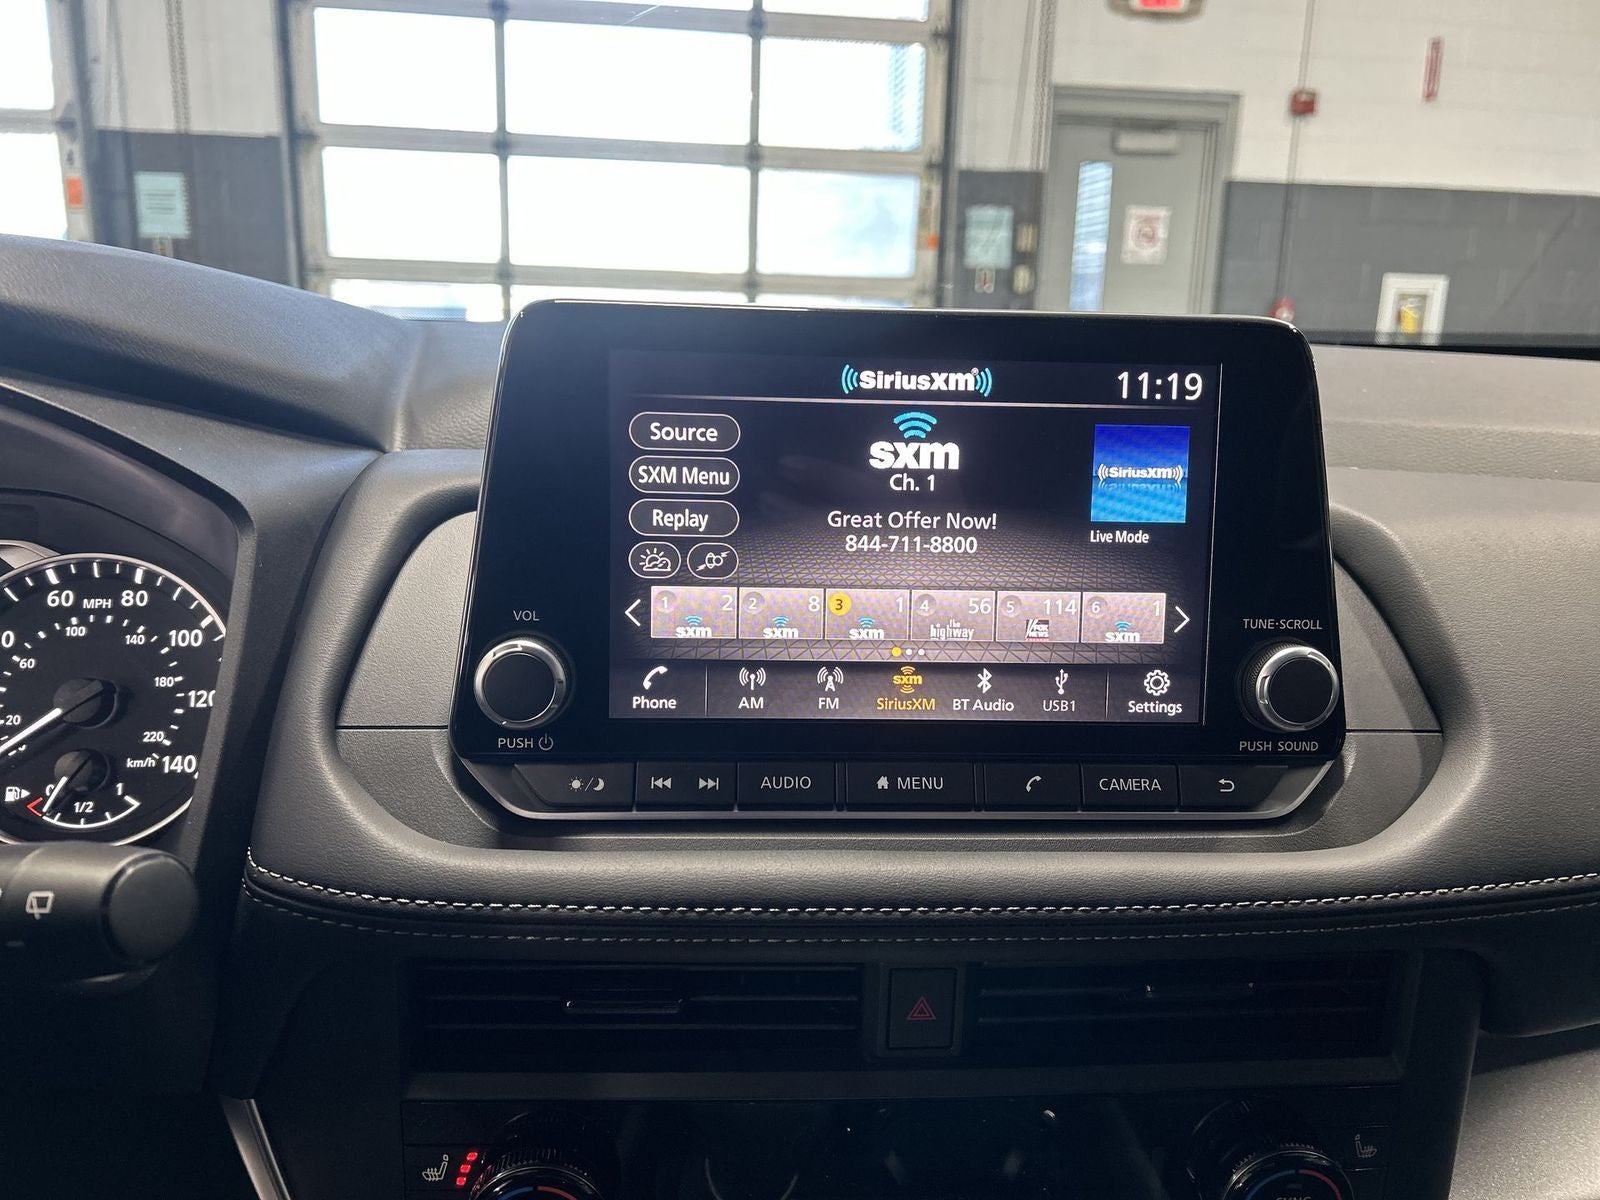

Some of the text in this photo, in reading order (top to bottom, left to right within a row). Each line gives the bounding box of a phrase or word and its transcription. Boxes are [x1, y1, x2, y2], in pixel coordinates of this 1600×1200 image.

[1117, 371, 1204, 401] 11:19
[650, 422, 718, 443] Source
[638, 465, 730, 487] SXM Menu
[889, 473, 936, 492] Ch. 1
[652, 509, 709, 532] Replay
[827, 510, 998, 531] Great Offer Now!
[1090, 530, 1149, 544] Live Mode
[844, 535, 978, 555] 844-711-8800
[46, 589, 74, 607] 60
[82, 597, 112, 609] MPH
[120, 589, 149, 607] 80
[661, 597, 669, 609] 1
[722, 595, 733, 611] 2
[748, 598, 757, 610] 2
[808, 596, 820, 612] 8
[834, 599, 844, 611] 3
[895, 597, 904, 613] 1
[919, 600, 930, 613] 4
[968, 598, 991, 615] 56
[1006, 602, 1015, 614] 5
[1043, 599, 1077, 615] 114
[1091, 601, 1101, 614] 6
[1152, 601, 1161, 617] 1
[513, 609, 540, 622] VOL
[64, 626, 86, 637] 100
[168, 629, 203, 648] 100
[930, 624, 975, 640] highway
[0, 630, 15, 648] 0
[125, 634, 146, 645] 140
[19, 658, 36, 669] 60
[154, 676, 175, 687] 180
[632, 696, 677, 709] Phone
[738, 697, 764, 709] AM
[818, 697, 840, 709] FM
[876, 698, 936, 711] SiriusXM
[952, 698, 1015, 712] BT Audio
[1042, 699, 1076, 712] USB1
[1127, 700, 1183, 716] Settings
[5, 714, 21, 726] 20
[142, 731, 165, 743] 220
[497, 737, 534, 750] PUSH
[1239, 740, 1319, 753] PUSH SOUND
[126, 757, 156, 769] km/h
[162, 754, 197, 773] 140
[116, 782, 124, 796] 1
[760, 776, 812, 791] AUDIO
[897, 776, 944, 791] MENU
[1099, 778, 1162, 793] CAMERA
[73, 801, 95, 813] 1/2
